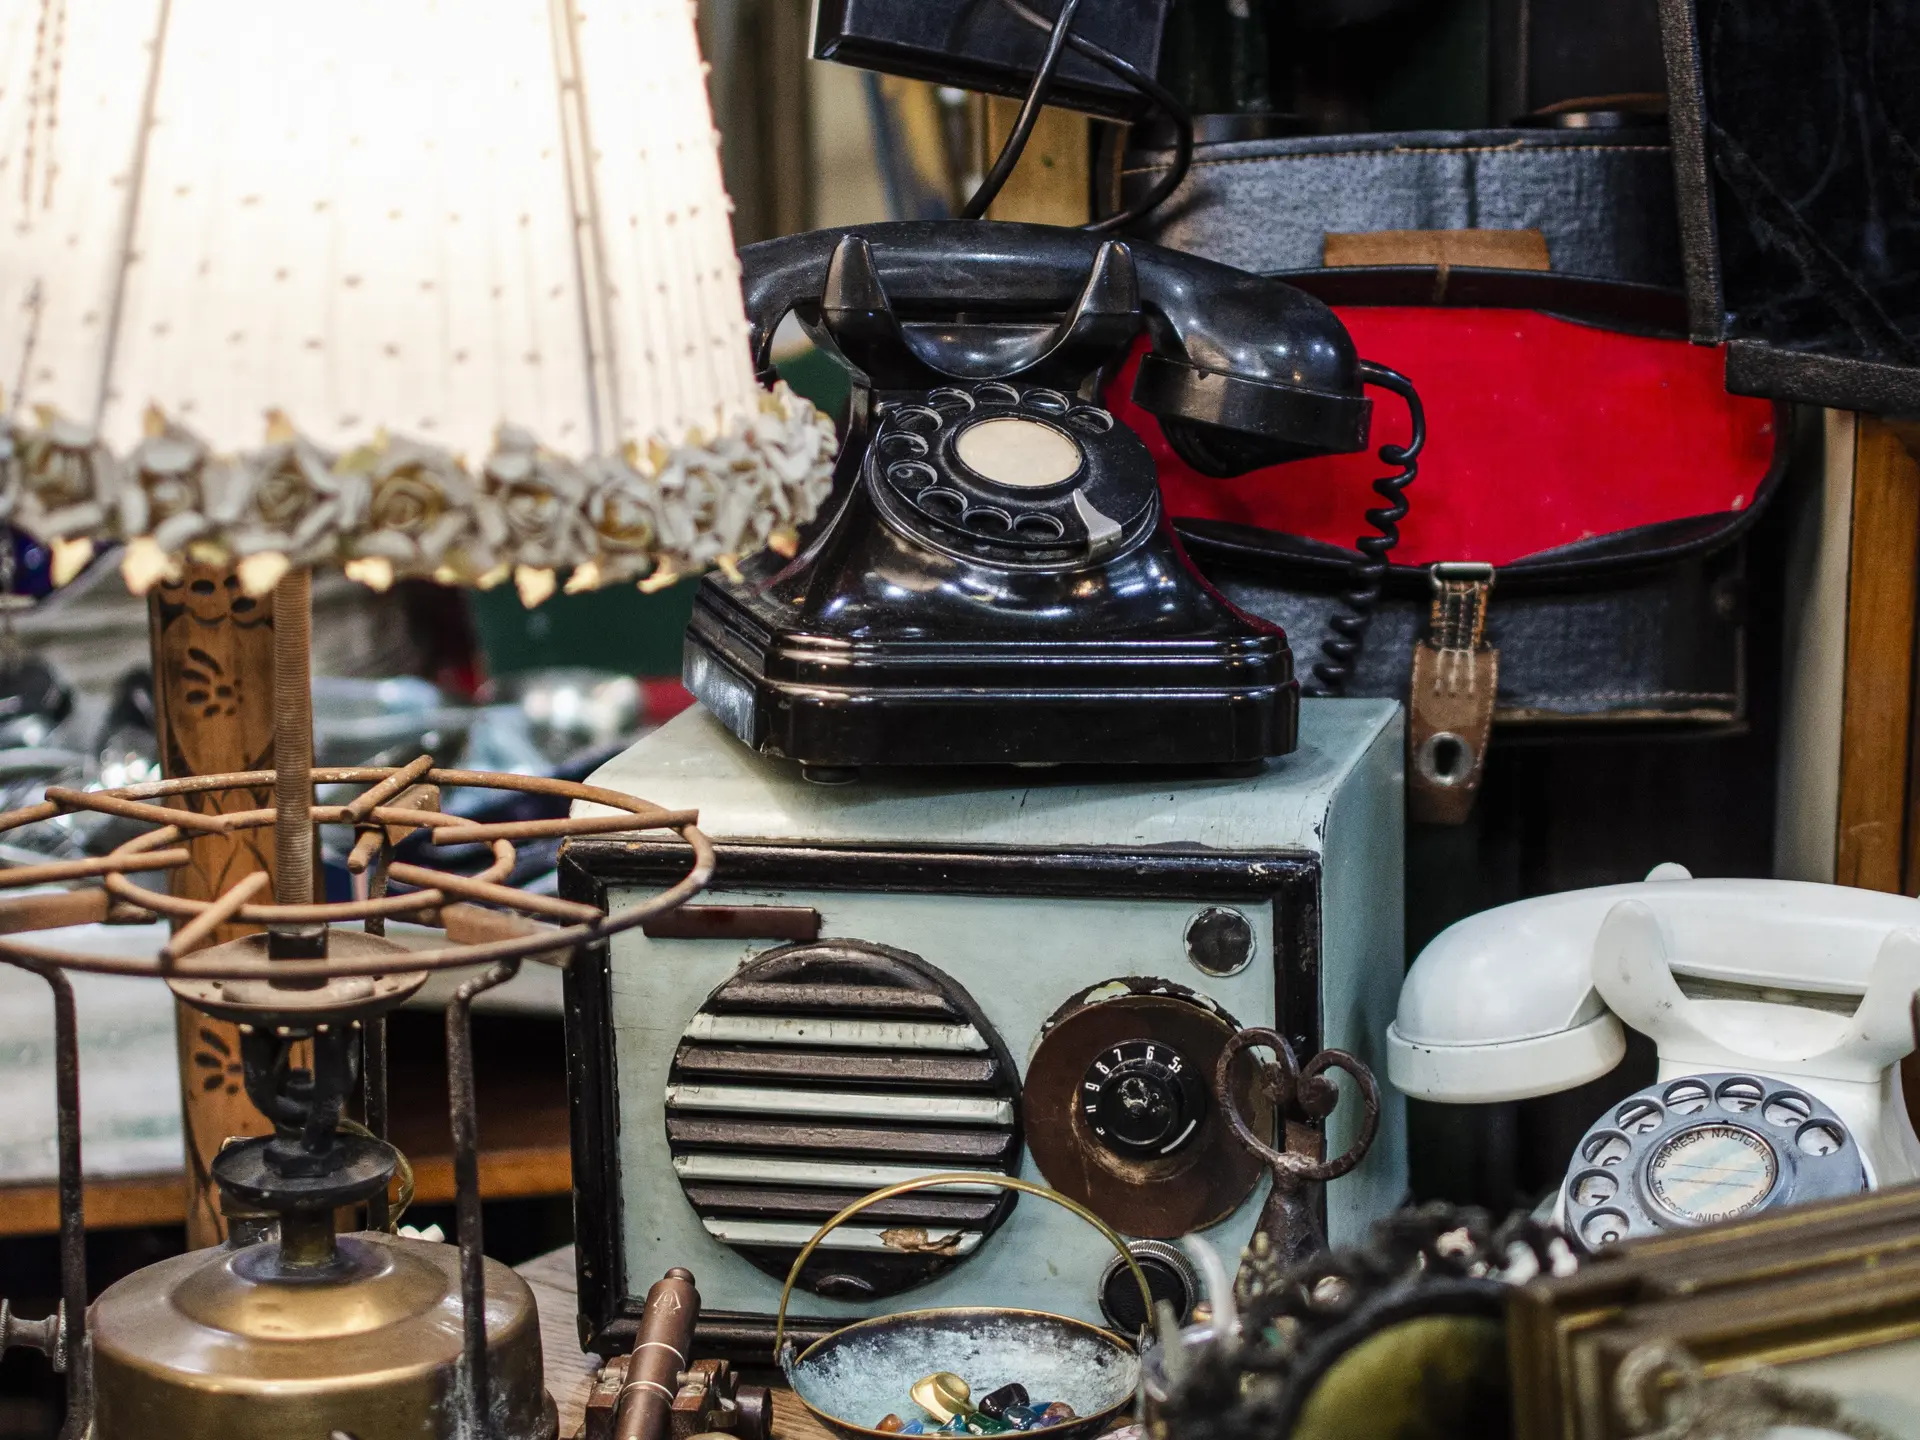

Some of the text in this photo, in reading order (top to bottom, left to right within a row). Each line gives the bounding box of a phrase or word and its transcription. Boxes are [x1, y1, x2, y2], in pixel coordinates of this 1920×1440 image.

[1113, 1048, 1122, 1062] 7
[1146, 1045, 1155, 1061] 6
[1095, 1061, 1111, 1075] 8
[1084, 1082, 1100, 1092] 9
[1085, 1104, 1097, 1113] 11
[1656, 1130, 1704, 1169] EMPRESA
[1711, 1128, 1769, 1162] NACIONAL
